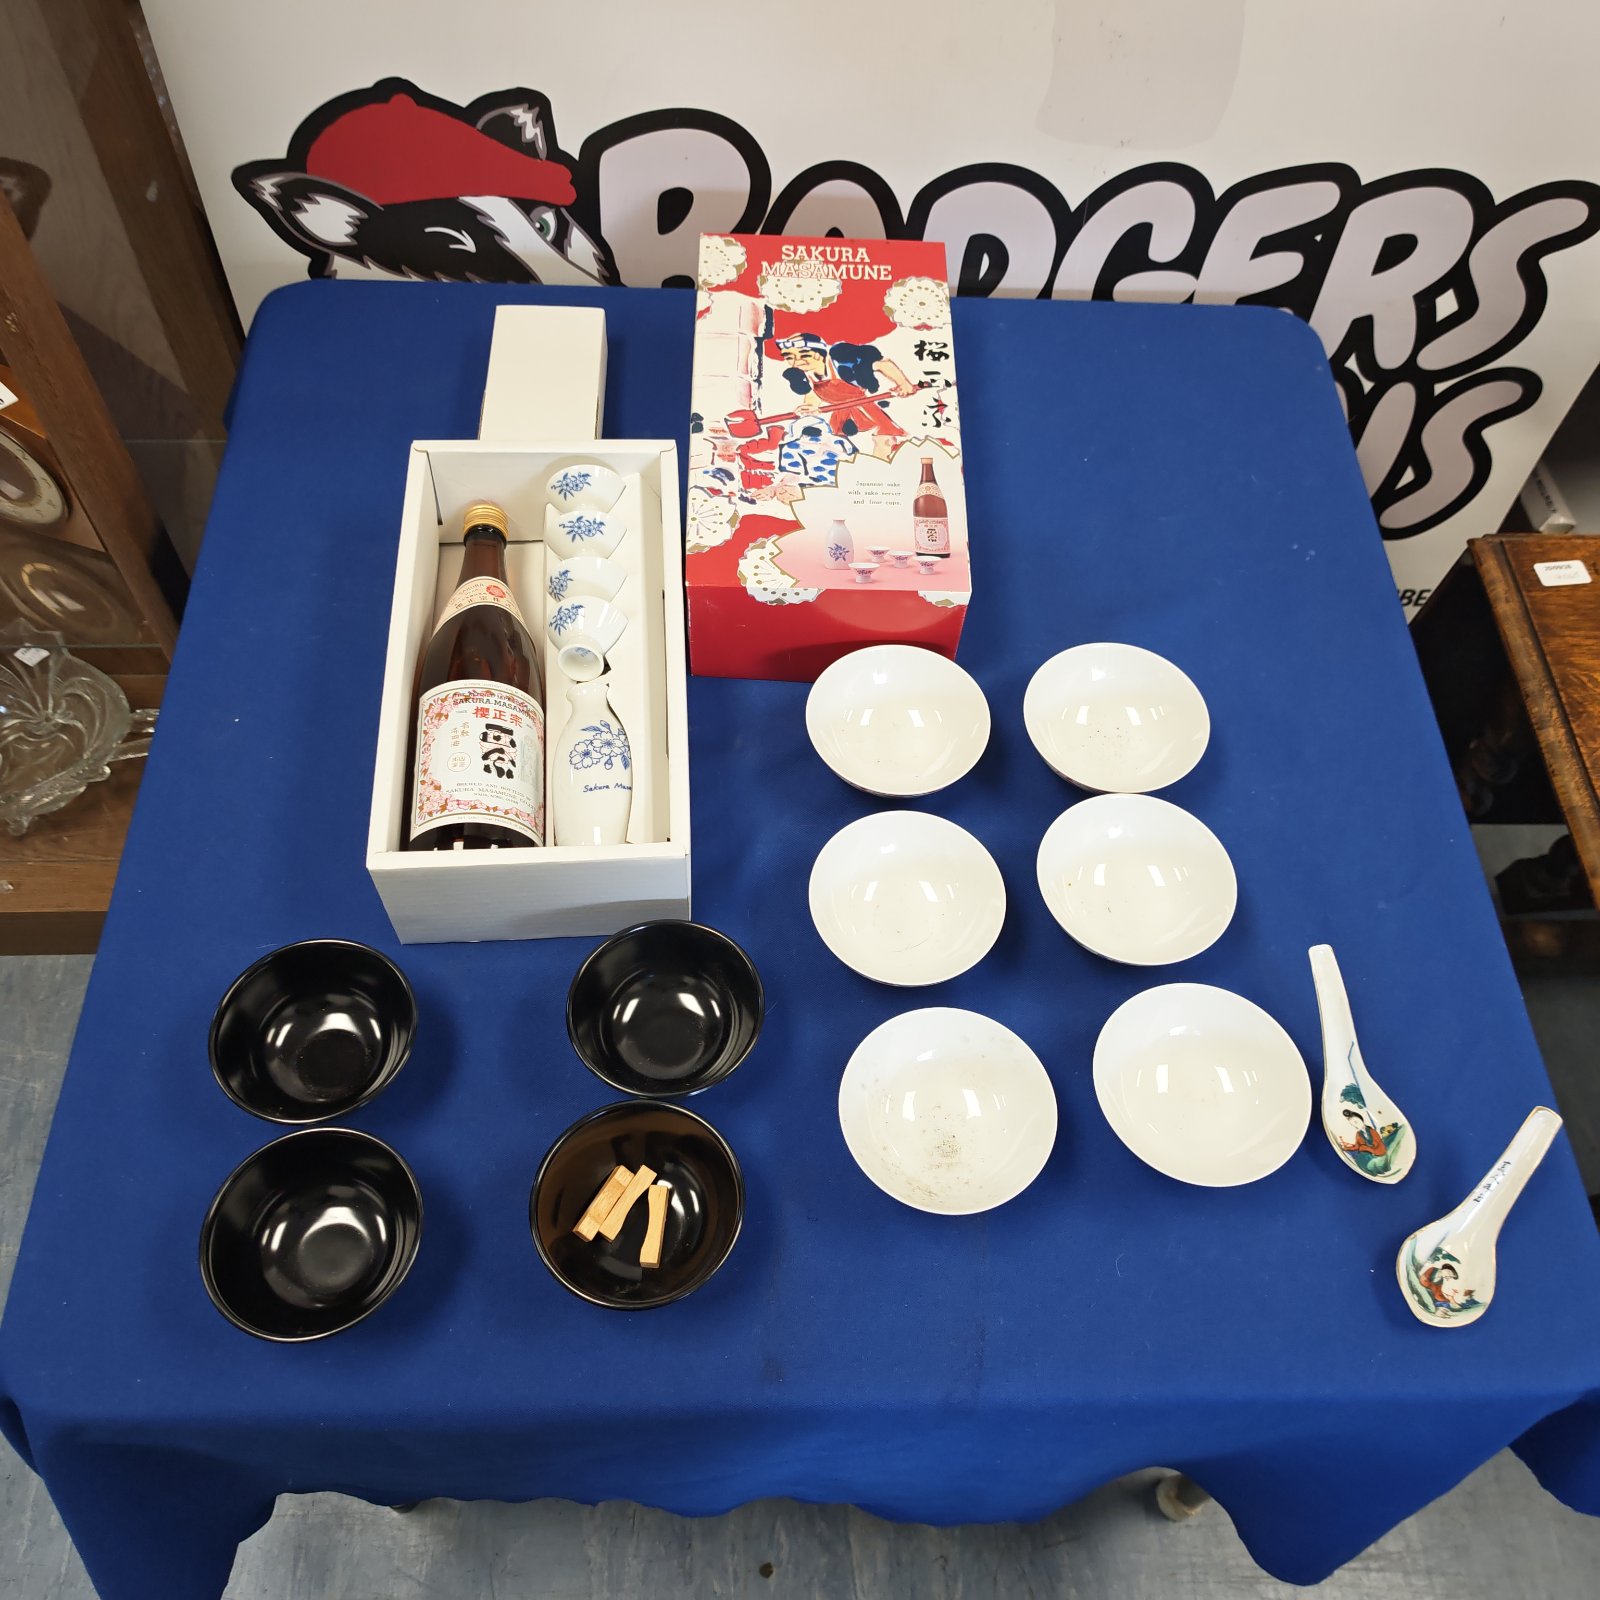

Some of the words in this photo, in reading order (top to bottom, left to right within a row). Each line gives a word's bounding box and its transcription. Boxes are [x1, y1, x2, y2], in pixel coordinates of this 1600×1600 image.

[781, 245, 870, 263] SAKURA
[761, 261, 892, 281] MASAMUNE
[855, 480, 884, 488] Japanese
[453, 697, 491, 706] SAKURA
[583, 783, 610, 793] Sakura
